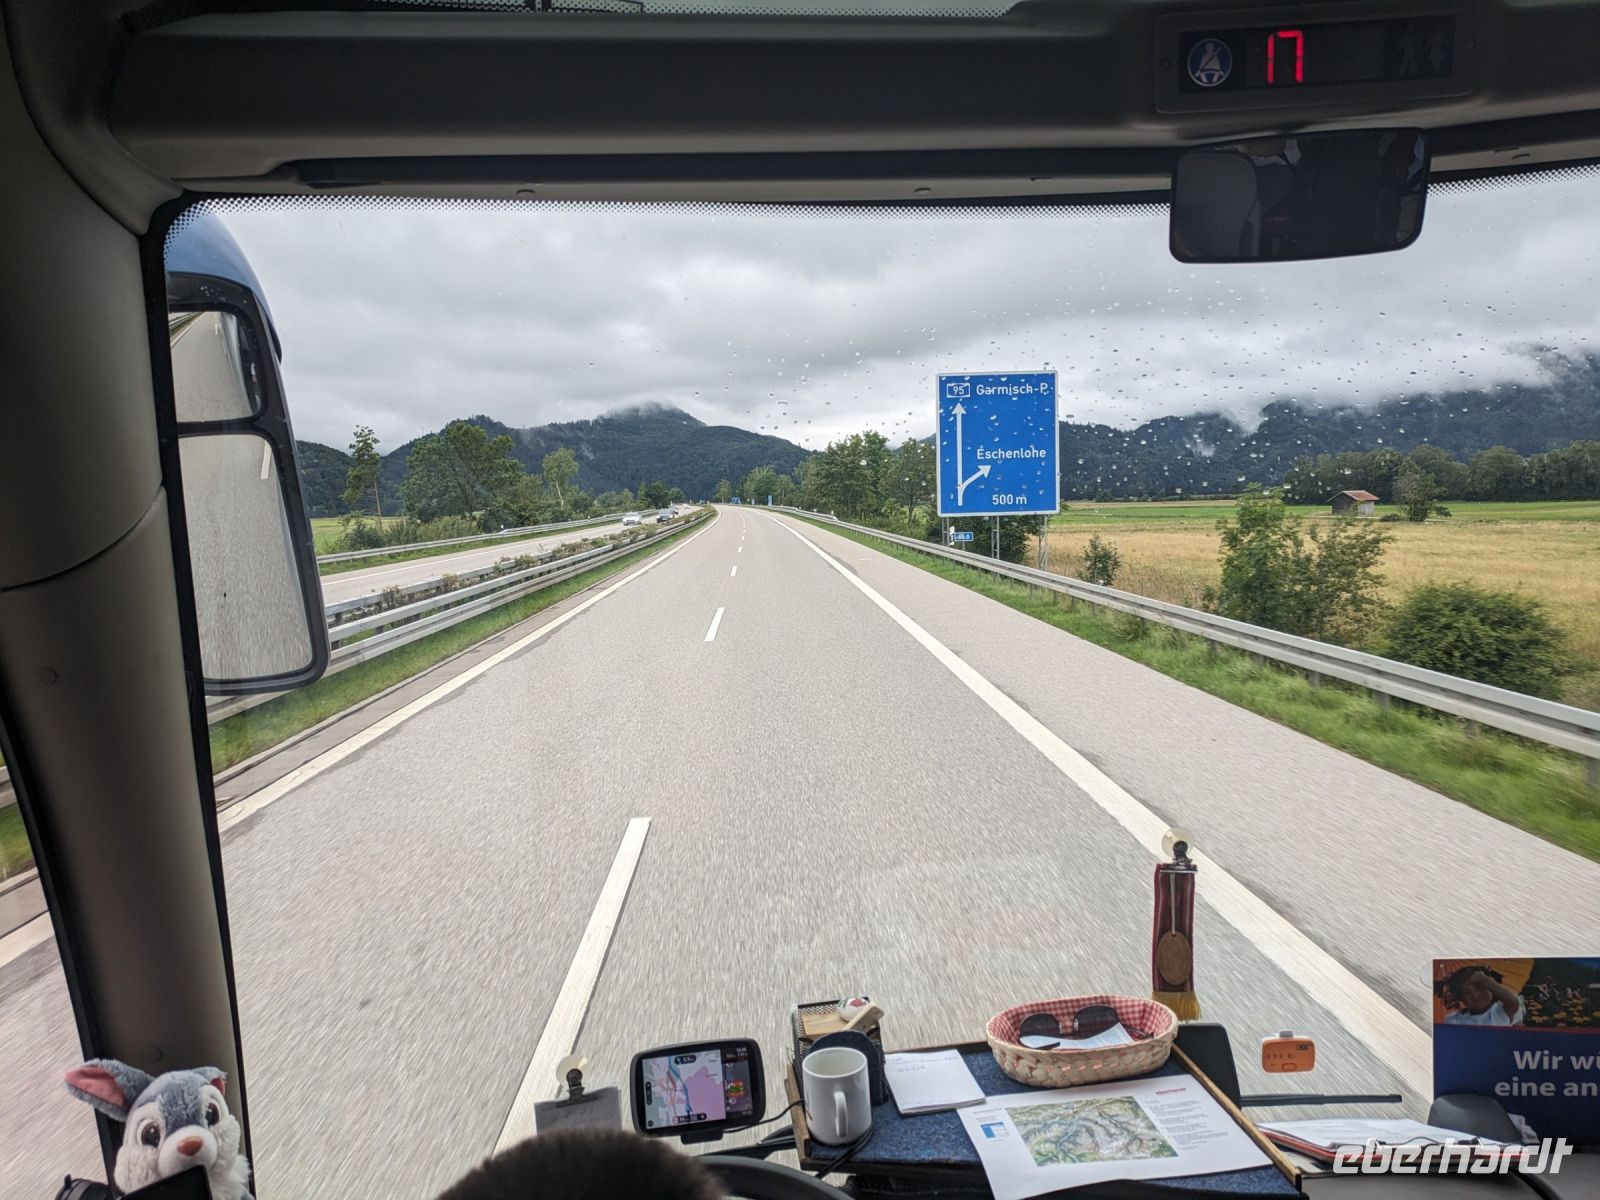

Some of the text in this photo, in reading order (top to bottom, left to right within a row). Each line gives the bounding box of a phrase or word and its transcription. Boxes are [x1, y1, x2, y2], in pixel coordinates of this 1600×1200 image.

[1267, 31, 1303, 84] 17
[952, 385, 965, 395] 95
[977, 447, 1047, 460] Eschenlohe
[992, 494, 1027, 505] 500 m
[1513, 1050, 1600, 1070] Wir w
[1494, 1076, 1556, 1096] eine
